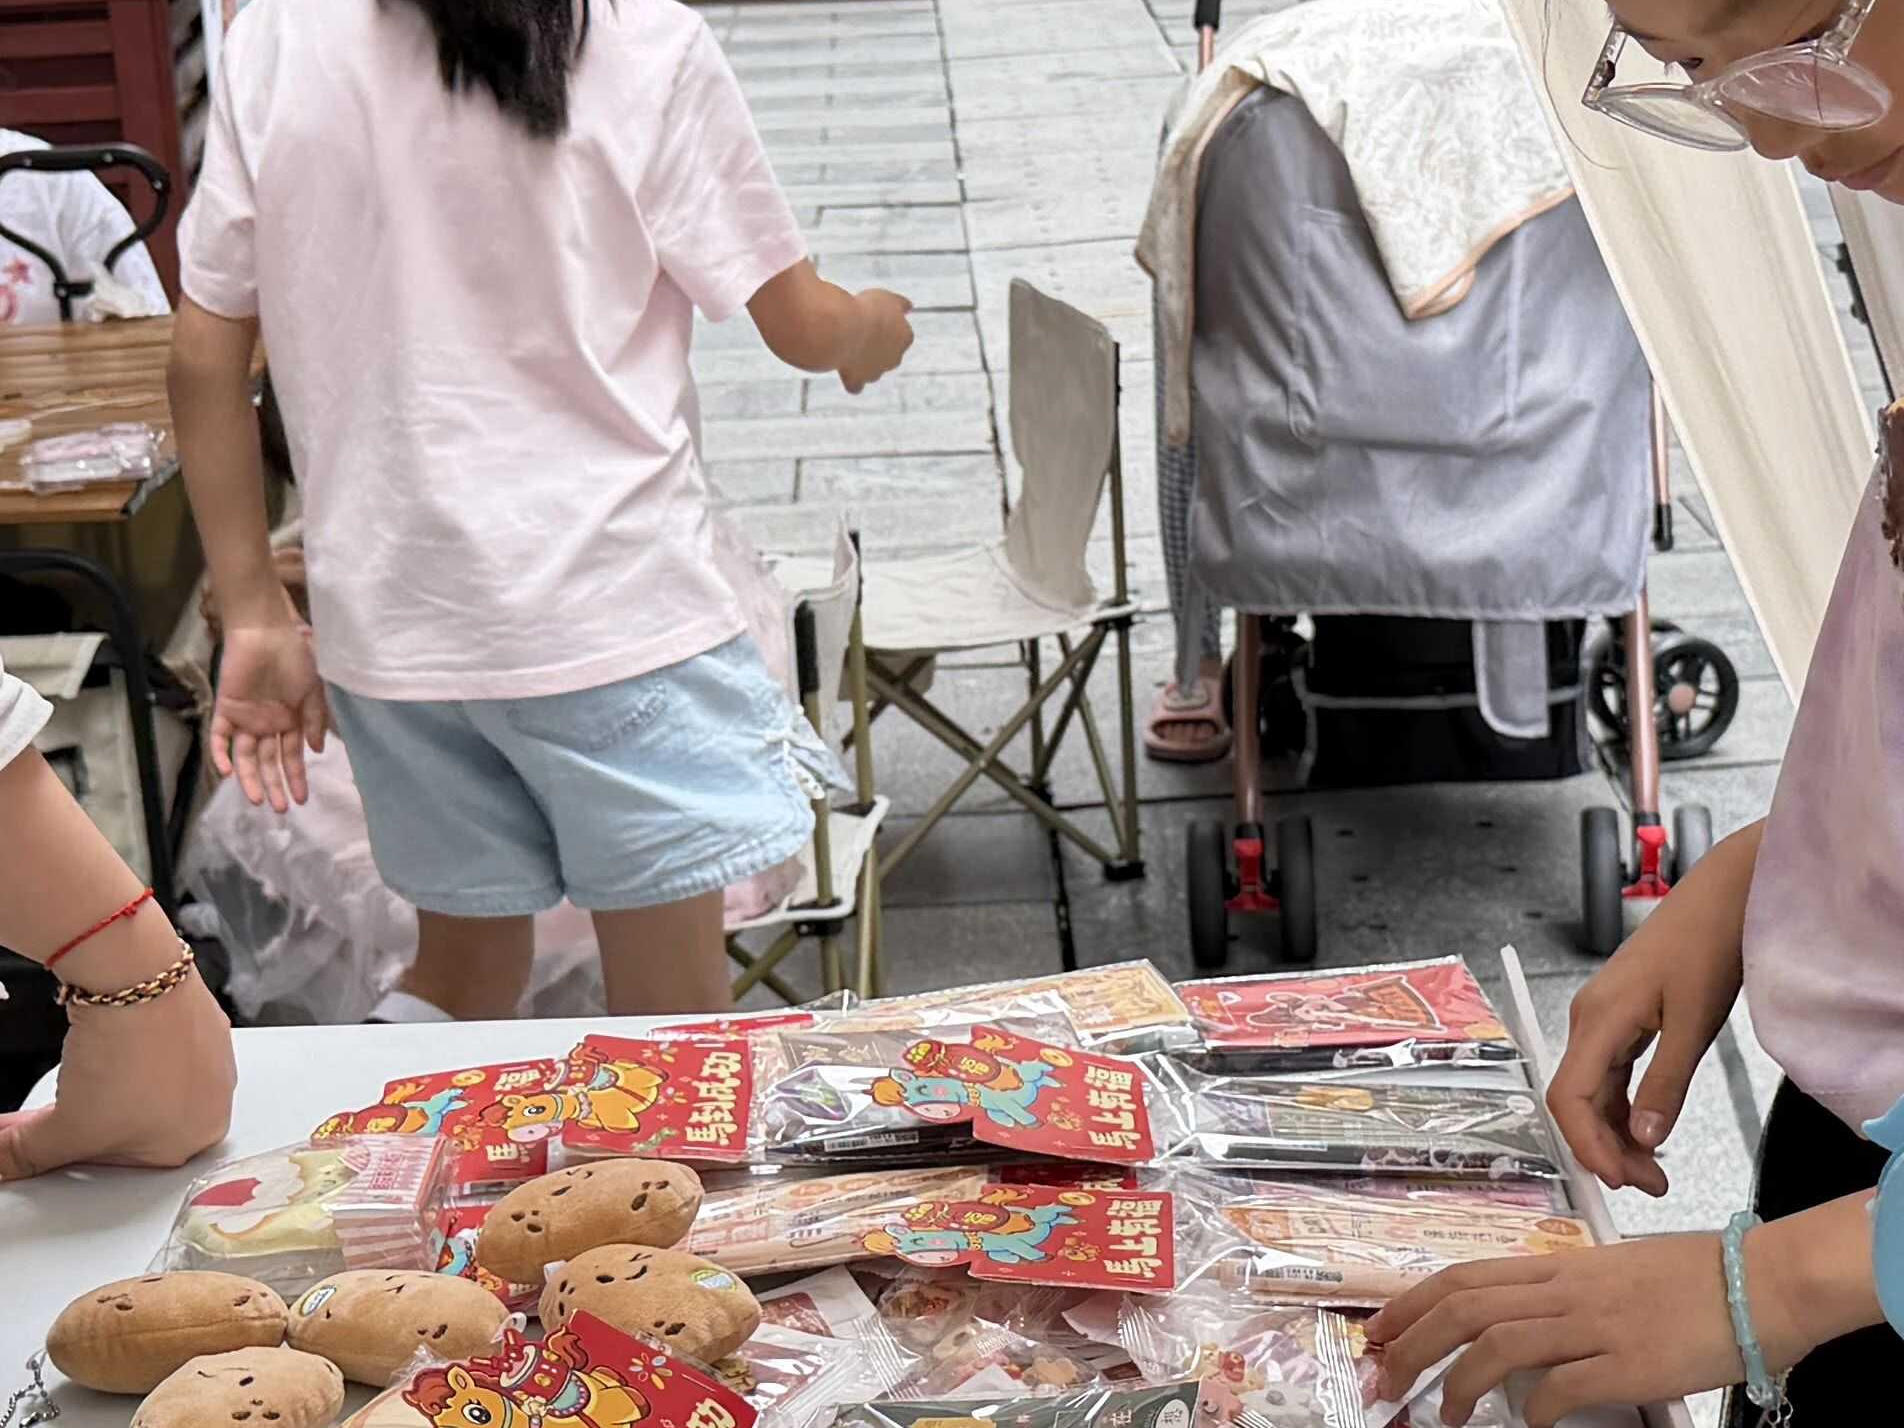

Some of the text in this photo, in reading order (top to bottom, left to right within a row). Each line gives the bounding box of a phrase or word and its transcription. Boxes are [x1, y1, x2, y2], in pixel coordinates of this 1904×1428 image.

[685, 1051, 743, 1147] 馬到成功
[1088, 1066, 1136, 1153] 馬上有福
[1102, 1196, 1166, 1277] 馬上有福
